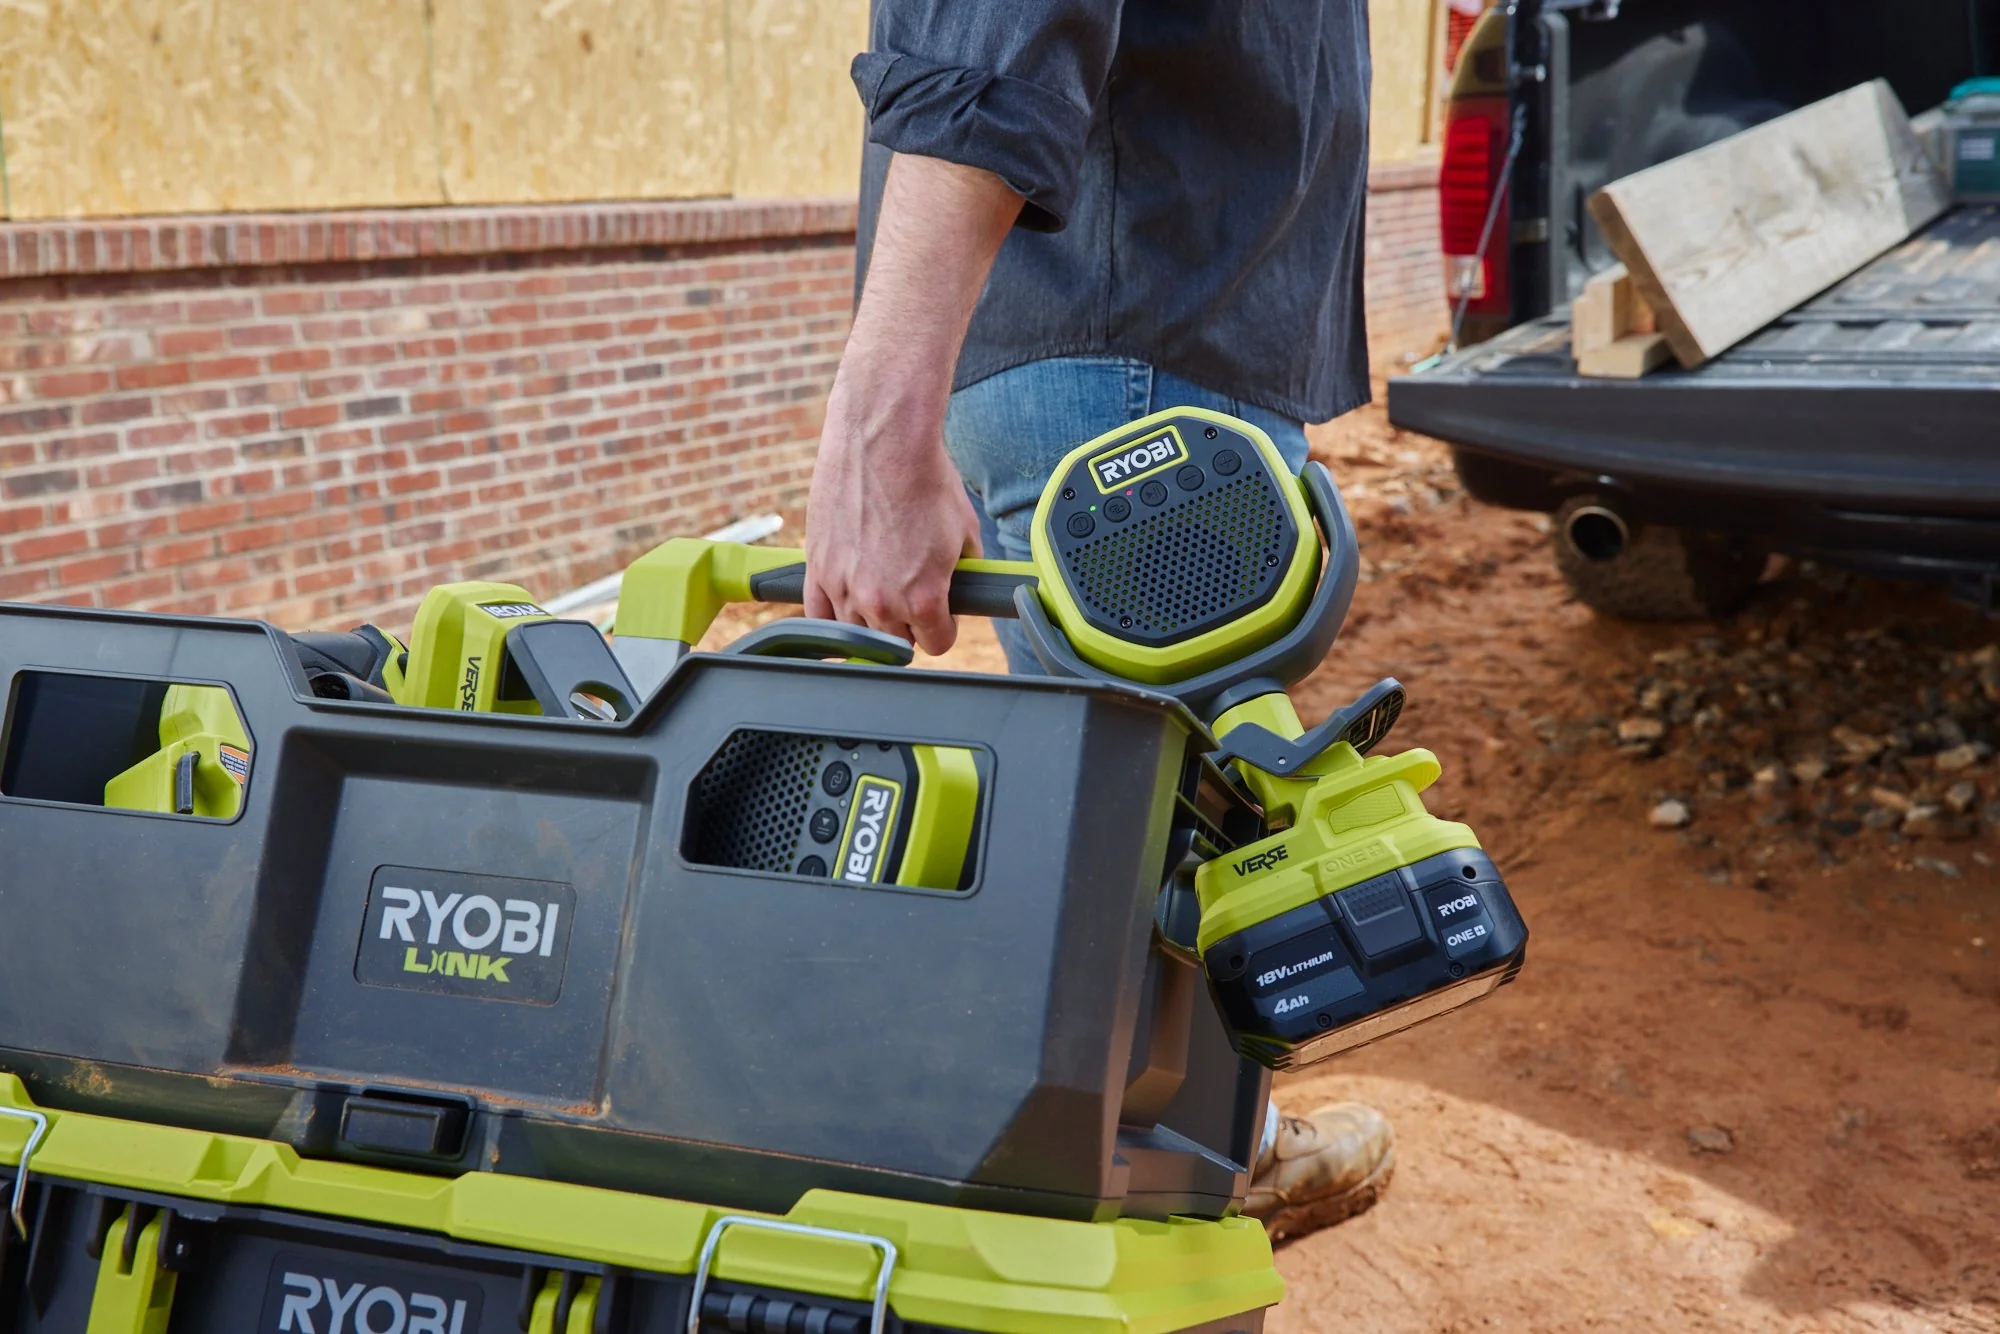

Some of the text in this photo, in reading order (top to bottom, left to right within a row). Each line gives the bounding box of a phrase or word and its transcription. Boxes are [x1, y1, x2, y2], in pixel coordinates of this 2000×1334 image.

[1098, 437, 1176, 483] RYOBI
[482, 604, 546, 618] RYOBI
[460, 656, 482, 712] VERSE
[844, 789, 890, 883] RYOBI
[1232, 844, 1289, 877] VERSE
[379, 886, 560, 957] RYOBI
[1437, 894, 1478, 917] RYOBI
[403, 947, 514, 983] LINK
[1273, 995, 1310, 1015] 4Ah
[278, 1271, 468, 1334] RYOBI
